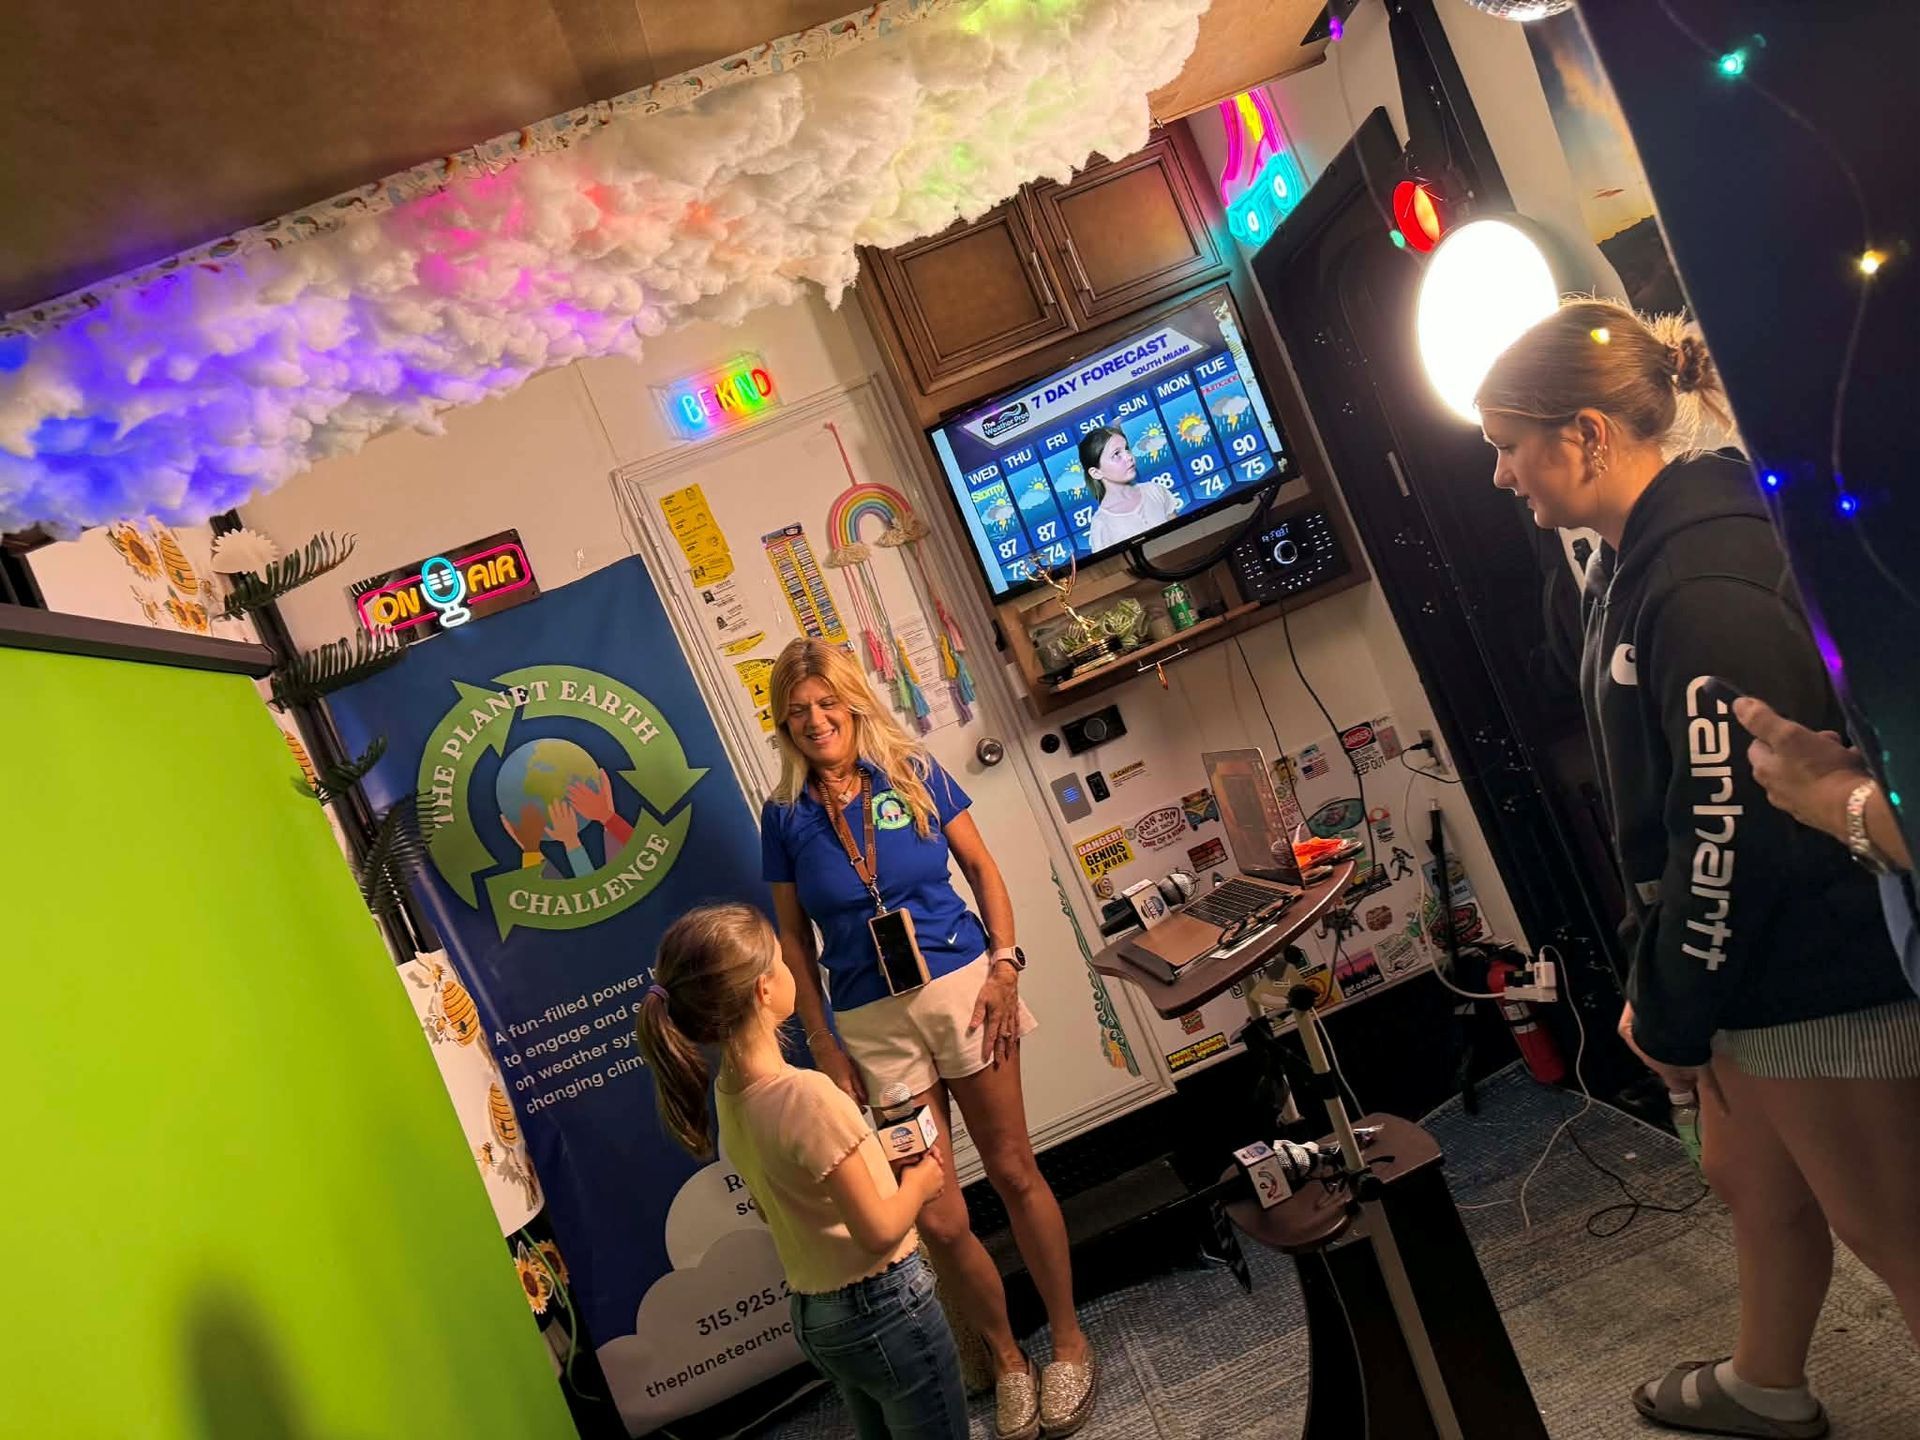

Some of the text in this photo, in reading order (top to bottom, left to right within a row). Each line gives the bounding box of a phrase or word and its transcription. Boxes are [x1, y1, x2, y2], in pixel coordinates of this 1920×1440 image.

[1031, 334, 1169, 409] 7 DAY FORECAST
[1131, 344, 1190, 378] SOUTH MIAMI
[681, 367, 772, 425] BE KIND
[968, 357, 1228, 486] WED THU FRI SAT SUN MON TUE
[982, 420, 996, 430] The
[984, 418, 1014, 436] Weather
[998, 538, 1018, 560] 87
[1037, 520, 1057, 543] 87
[1073, 505, 1094, 528] 87
[1190, 454, 1215, 476] 90
[1232, 434, 1257, 457] 90
[1043, 542, 1067, 564] 74
[1200, 474, 1226, 497] 74
[1240, 456, 1266, 479] 75
[467, 554, 518, 594] AIR
[372, 588, 421, 625] ON
[432, 680, 661, 829] THE PLANET EARTH
[1370, 756, 1386, 770] OUT
[1078, 828, 1124, 856] DANGER!
[1139, 810, 1177, 835] RON JON
[508, 832, 671, 917] CHALLENGE
[1085, 841, 1127, 867] GENIUS
[1090, 852, 1130, 876] AT WORK
[494, 973, 645, 1046] A fun-filled power
[503, 1053, 522, 1068] to
[525, 1023, 592, 1059] engage
[593, 1006, 628, 1030] and
[515, 1074, 535, 1091] on
[538, 1042, 610, 1081] weather
[526, 1072, 605, 1115] changing
[695, 1280, 794, 1337] 315.925.2
[645, 1322, 793, 1399] theplanetearthc
